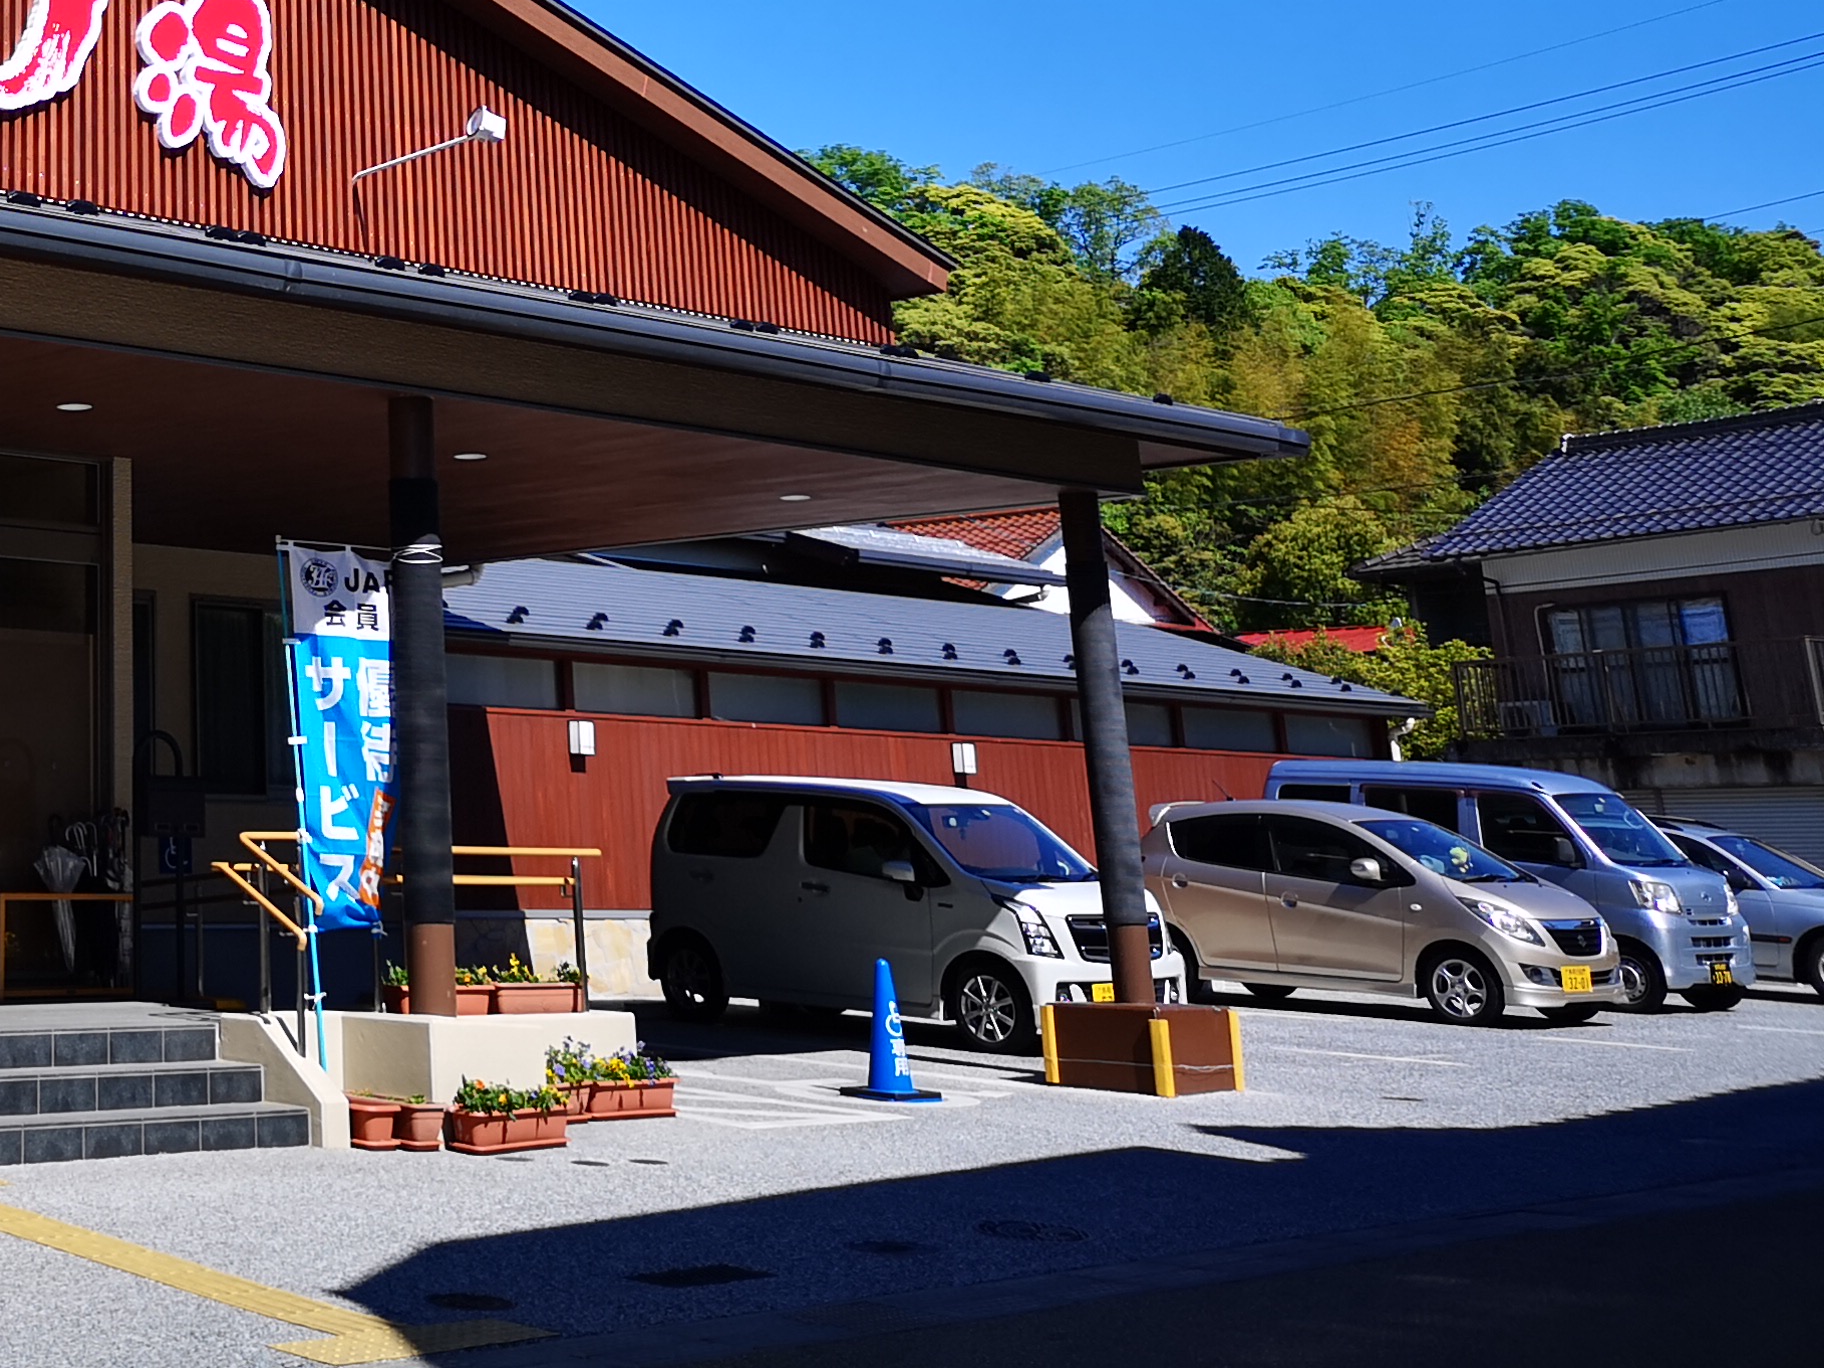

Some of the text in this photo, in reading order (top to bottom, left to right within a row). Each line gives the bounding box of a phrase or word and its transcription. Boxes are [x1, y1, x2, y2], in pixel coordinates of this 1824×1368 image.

[323, 599, 379, 631] 会員
[305, 656, 362, 903] サービス
